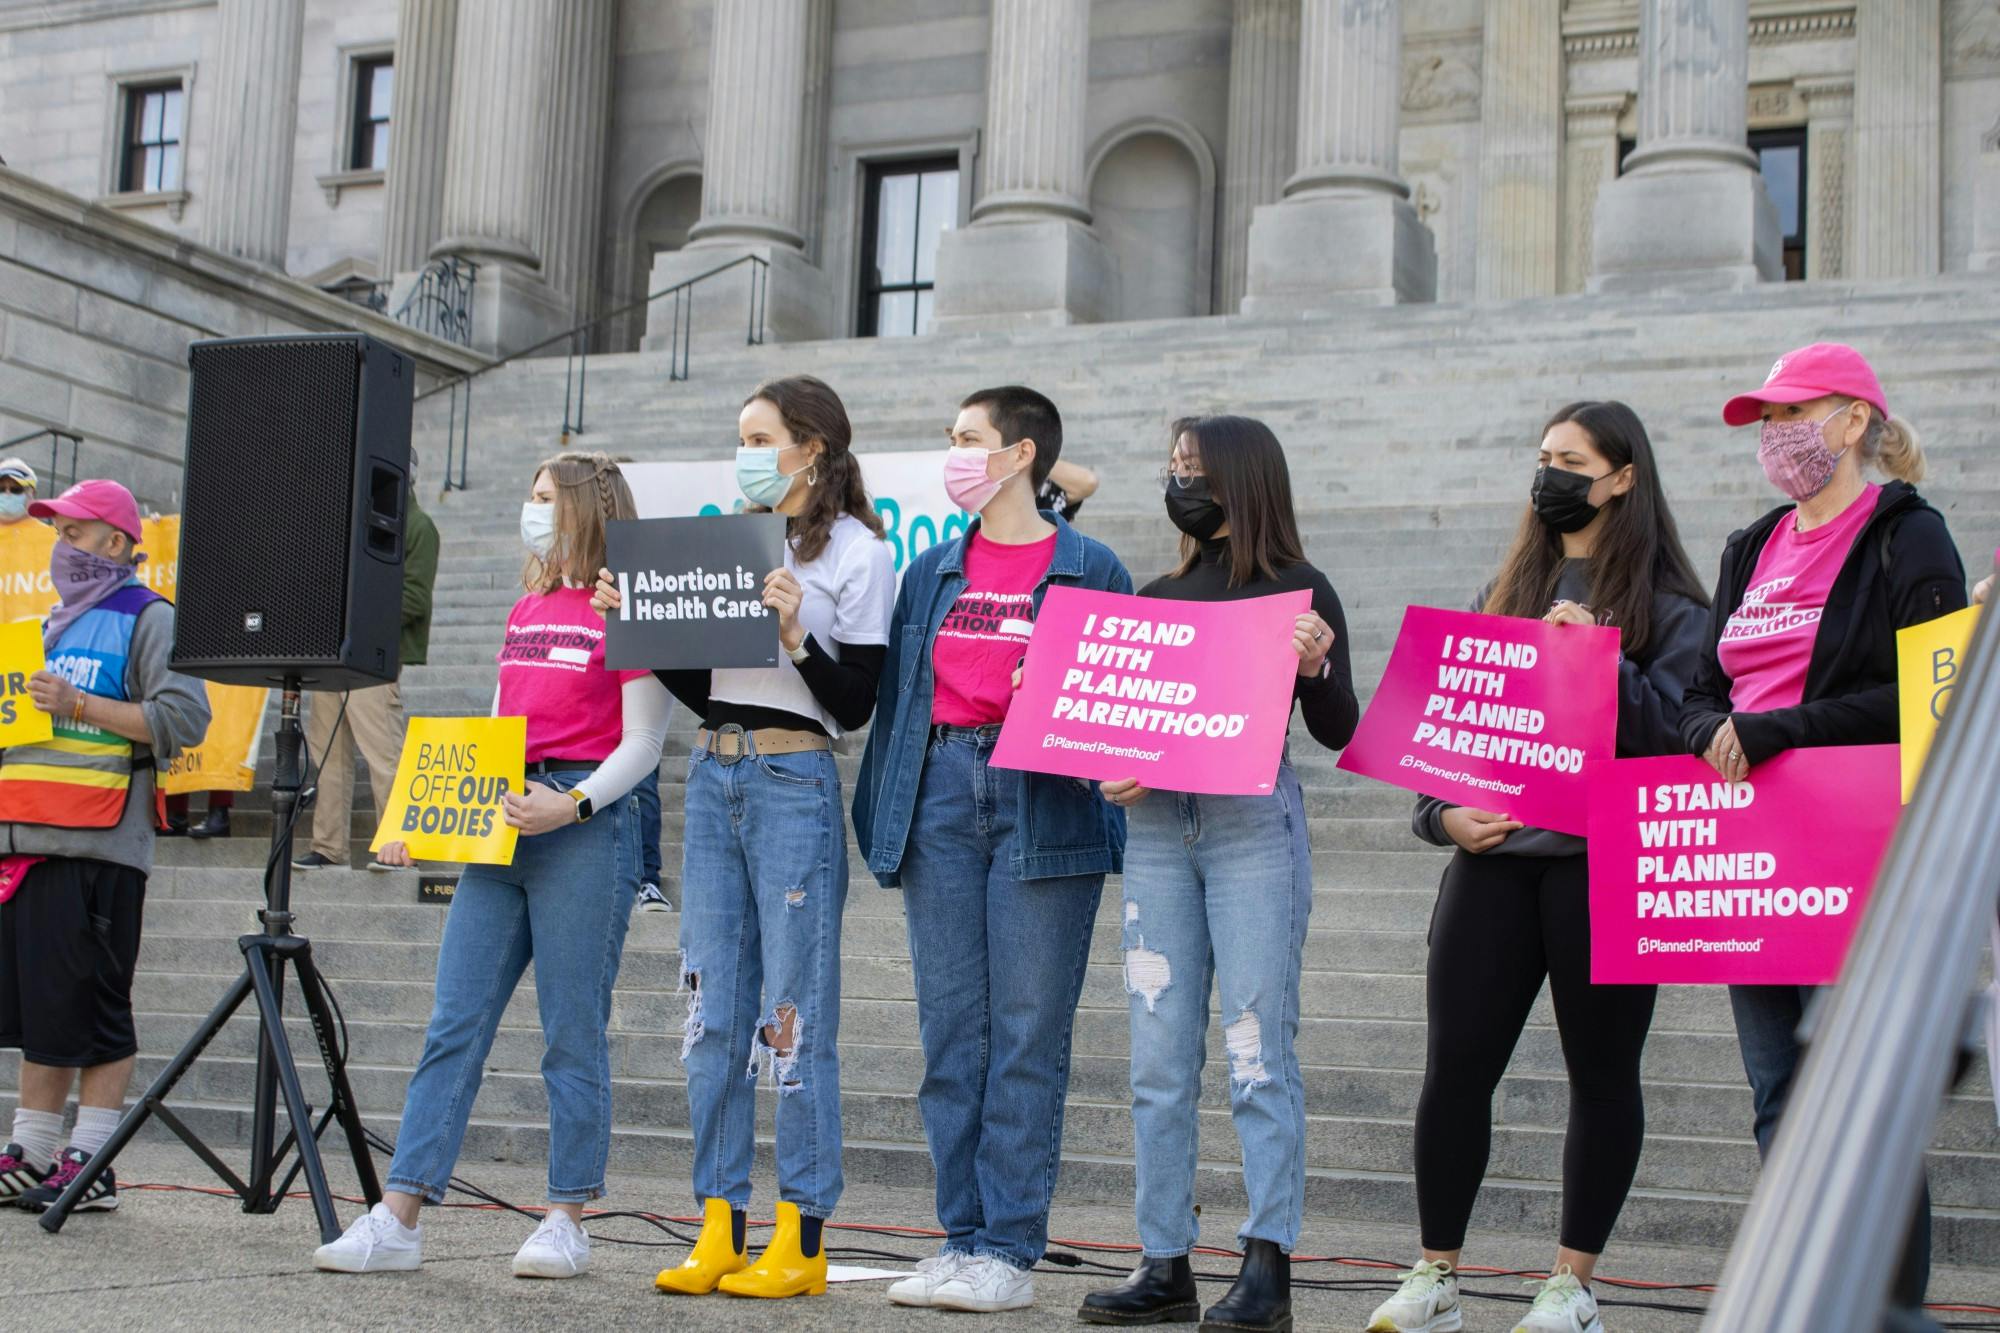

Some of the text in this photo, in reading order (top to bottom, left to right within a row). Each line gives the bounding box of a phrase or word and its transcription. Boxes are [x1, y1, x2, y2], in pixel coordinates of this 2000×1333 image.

[633, 565, 755, 593] Abortion is
[636, 596, 769, 621] Health Care.
[1082, 614, 1196, 647] I STAND
[1075, 640, 1153, 672] WITH
[1441, 635, 1538, 670] I STAND
[1061, 668, 1197, 706] PLANNED
[1437, 665, 1505, 697] WITH
[1052, 696, 1249, 738] PARENTHOOD
[1423, 694, 1545, 735] PLANNED
[416, 743, 477, 773] BANS
[1054, 736, 1098, 754] Planned
[1412, 722, 1585, 775] PARENTHOOD
[1412, 759, 1460, 782] Planned
[409, 774, 457, 803] OFF
[1637, 781, 1755, 813] I STAND
[401, 805, 496, 838] BODIES
[1639, 818, 1717, 848] WITH
[1637, 852, 1777, 884] PLANNED
[1637, 886, 1853, 918] PARENTHOOD
[1649, 938, 1694, 953] Planned
